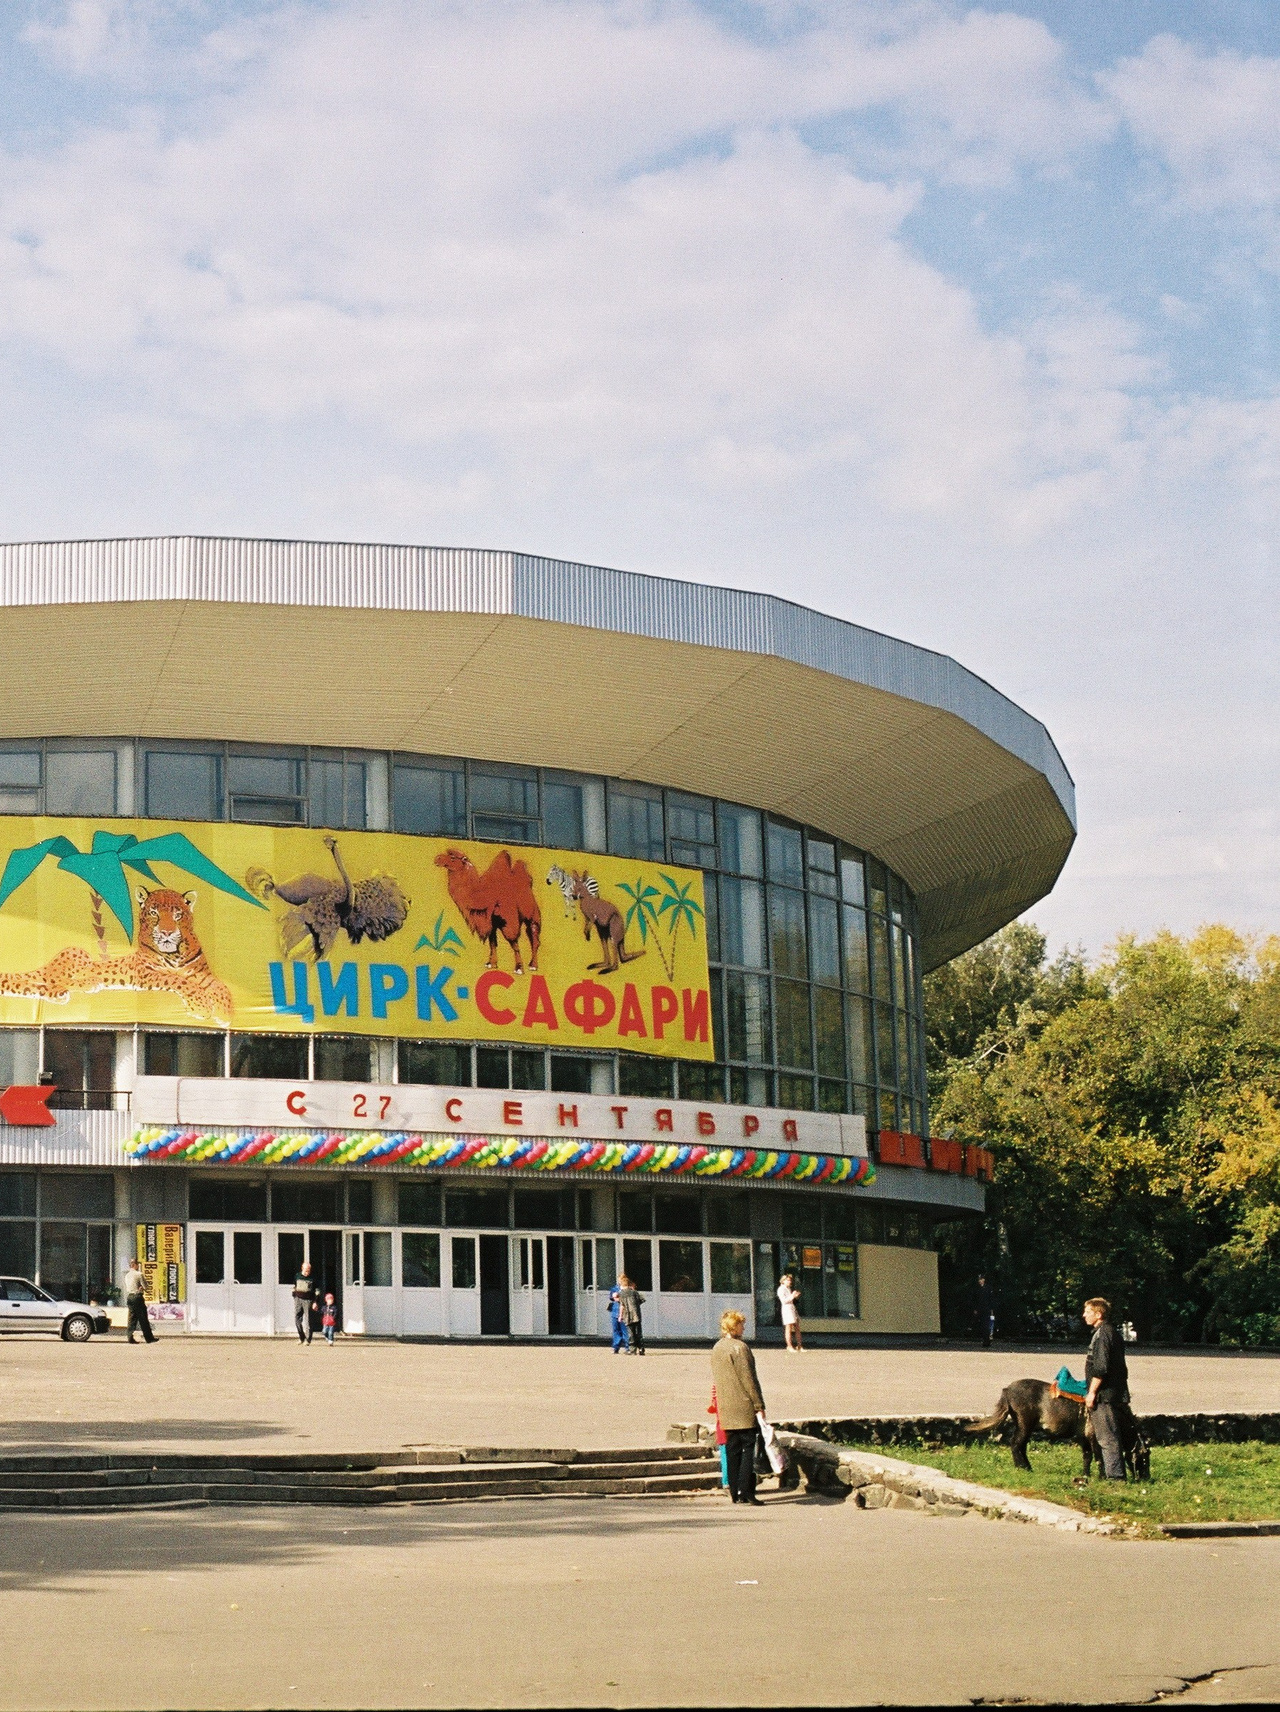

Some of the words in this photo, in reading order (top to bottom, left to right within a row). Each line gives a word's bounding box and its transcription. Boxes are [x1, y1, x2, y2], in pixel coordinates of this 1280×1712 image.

[286, 1090, 307, 1116] С
[352, 1093, 392, 1120] 27
[445, 1097, 799, 1143] СЕНТЯБРЯ
